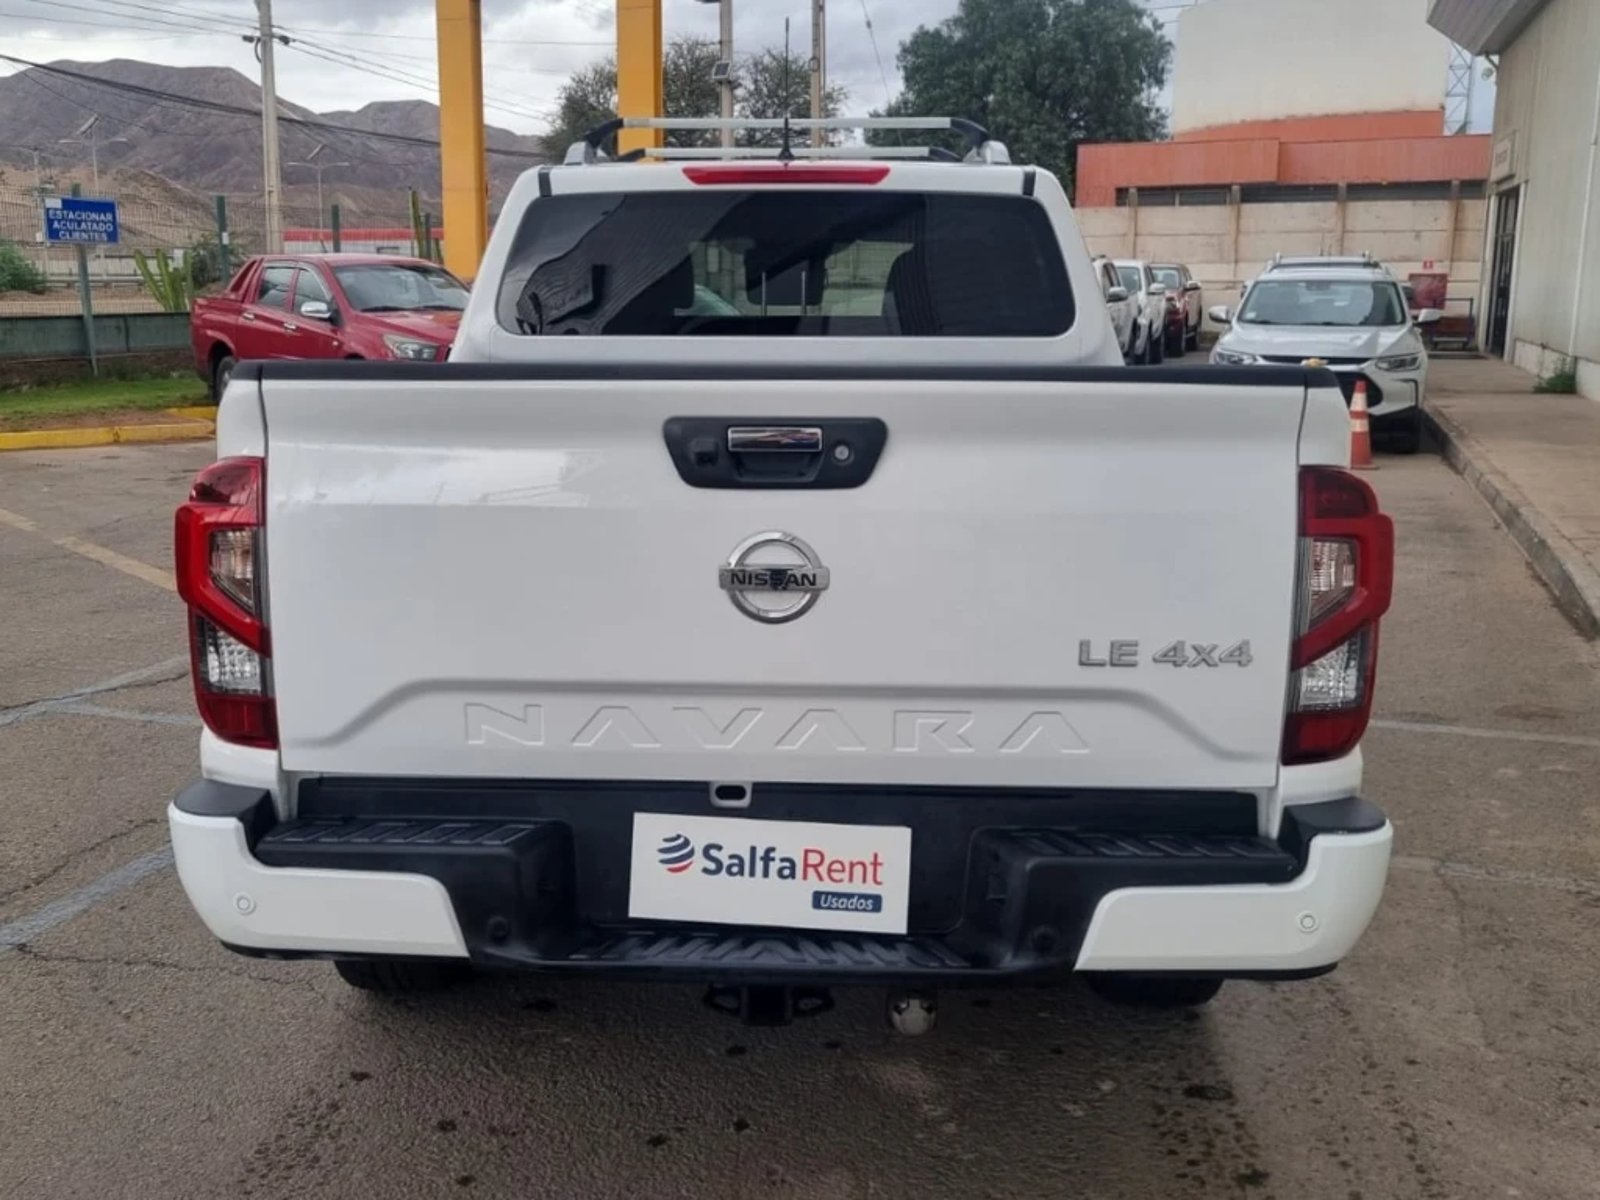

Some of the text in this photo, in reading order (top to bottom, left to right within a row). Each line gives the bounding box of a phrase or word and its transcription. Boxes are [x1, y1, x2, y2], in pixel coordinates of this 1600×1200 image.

[48, 209, 113, 222] ESTACIONAR
[52, 220, 114, 232] ACULATADO
[58, 230, 107, 241] CLIENTES
[1078, 639, 1254, 668] LE 4x4
[464, 703, 1090, 753] NAVARA
[700, 843, 883, 886] SalfaRent
[819, 893, 874, 911] Usados
